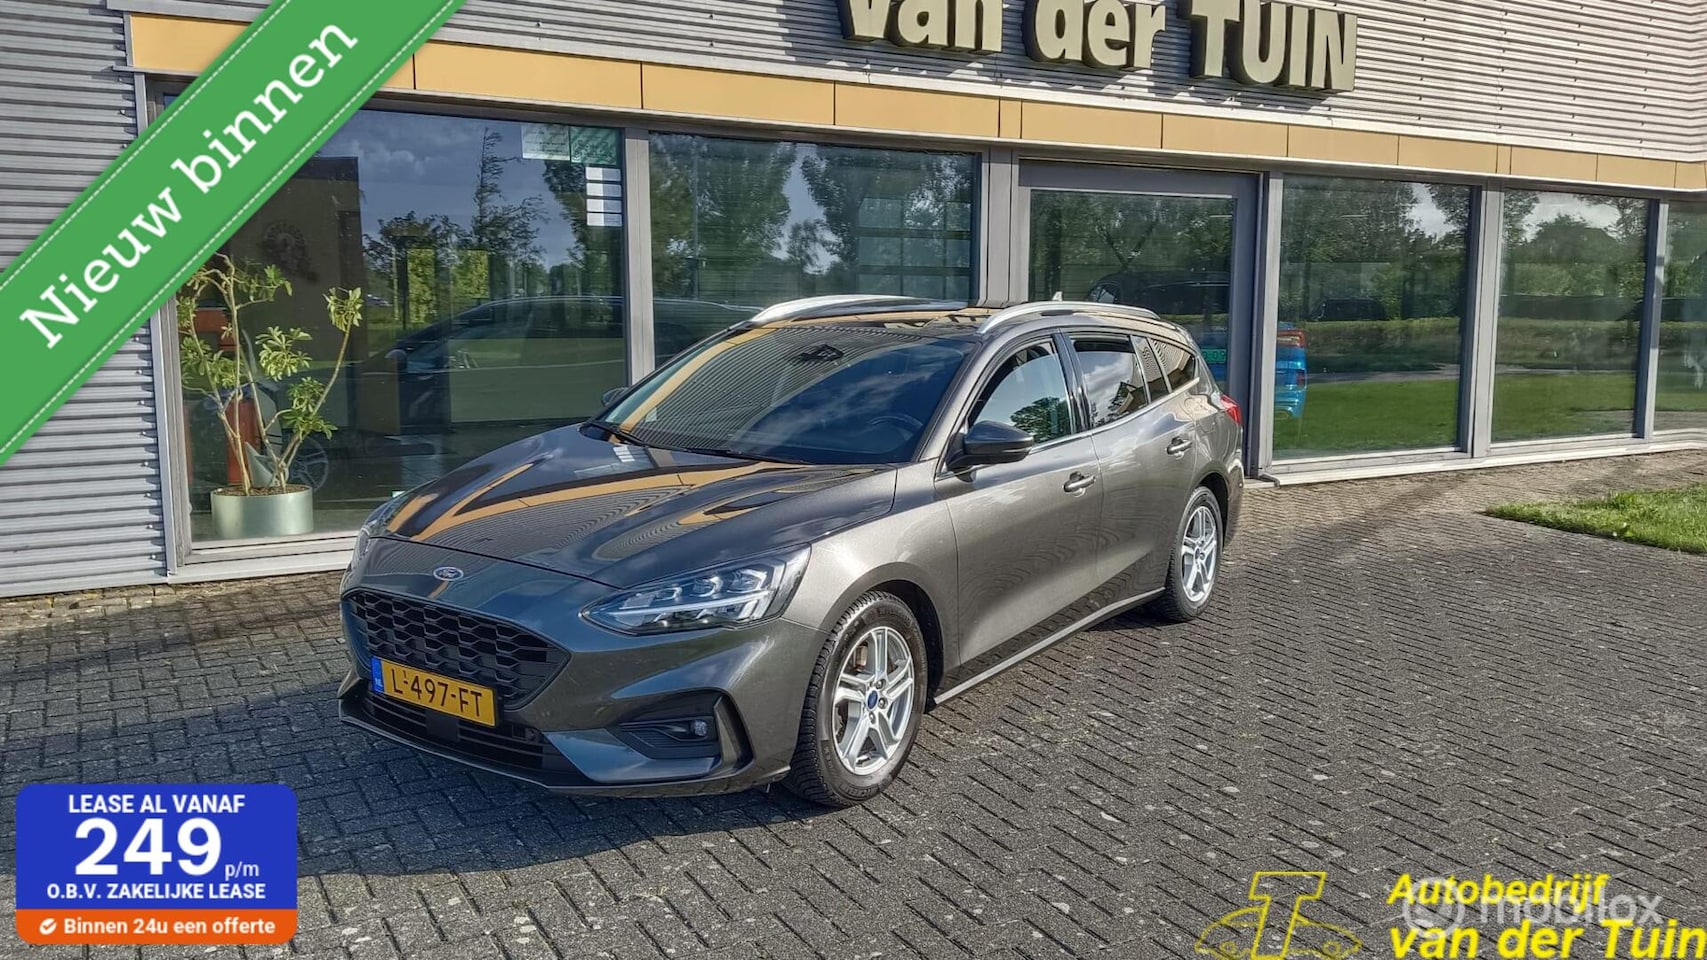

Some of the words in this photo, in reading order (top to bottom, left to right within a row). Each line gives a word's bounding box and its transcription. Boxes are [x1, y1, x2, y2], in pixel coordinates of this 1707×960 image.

[843, 0, 1002, 53] van
[1028, 0, 1166, 70] der
[1188, 0, 1357, 93] TUIN
